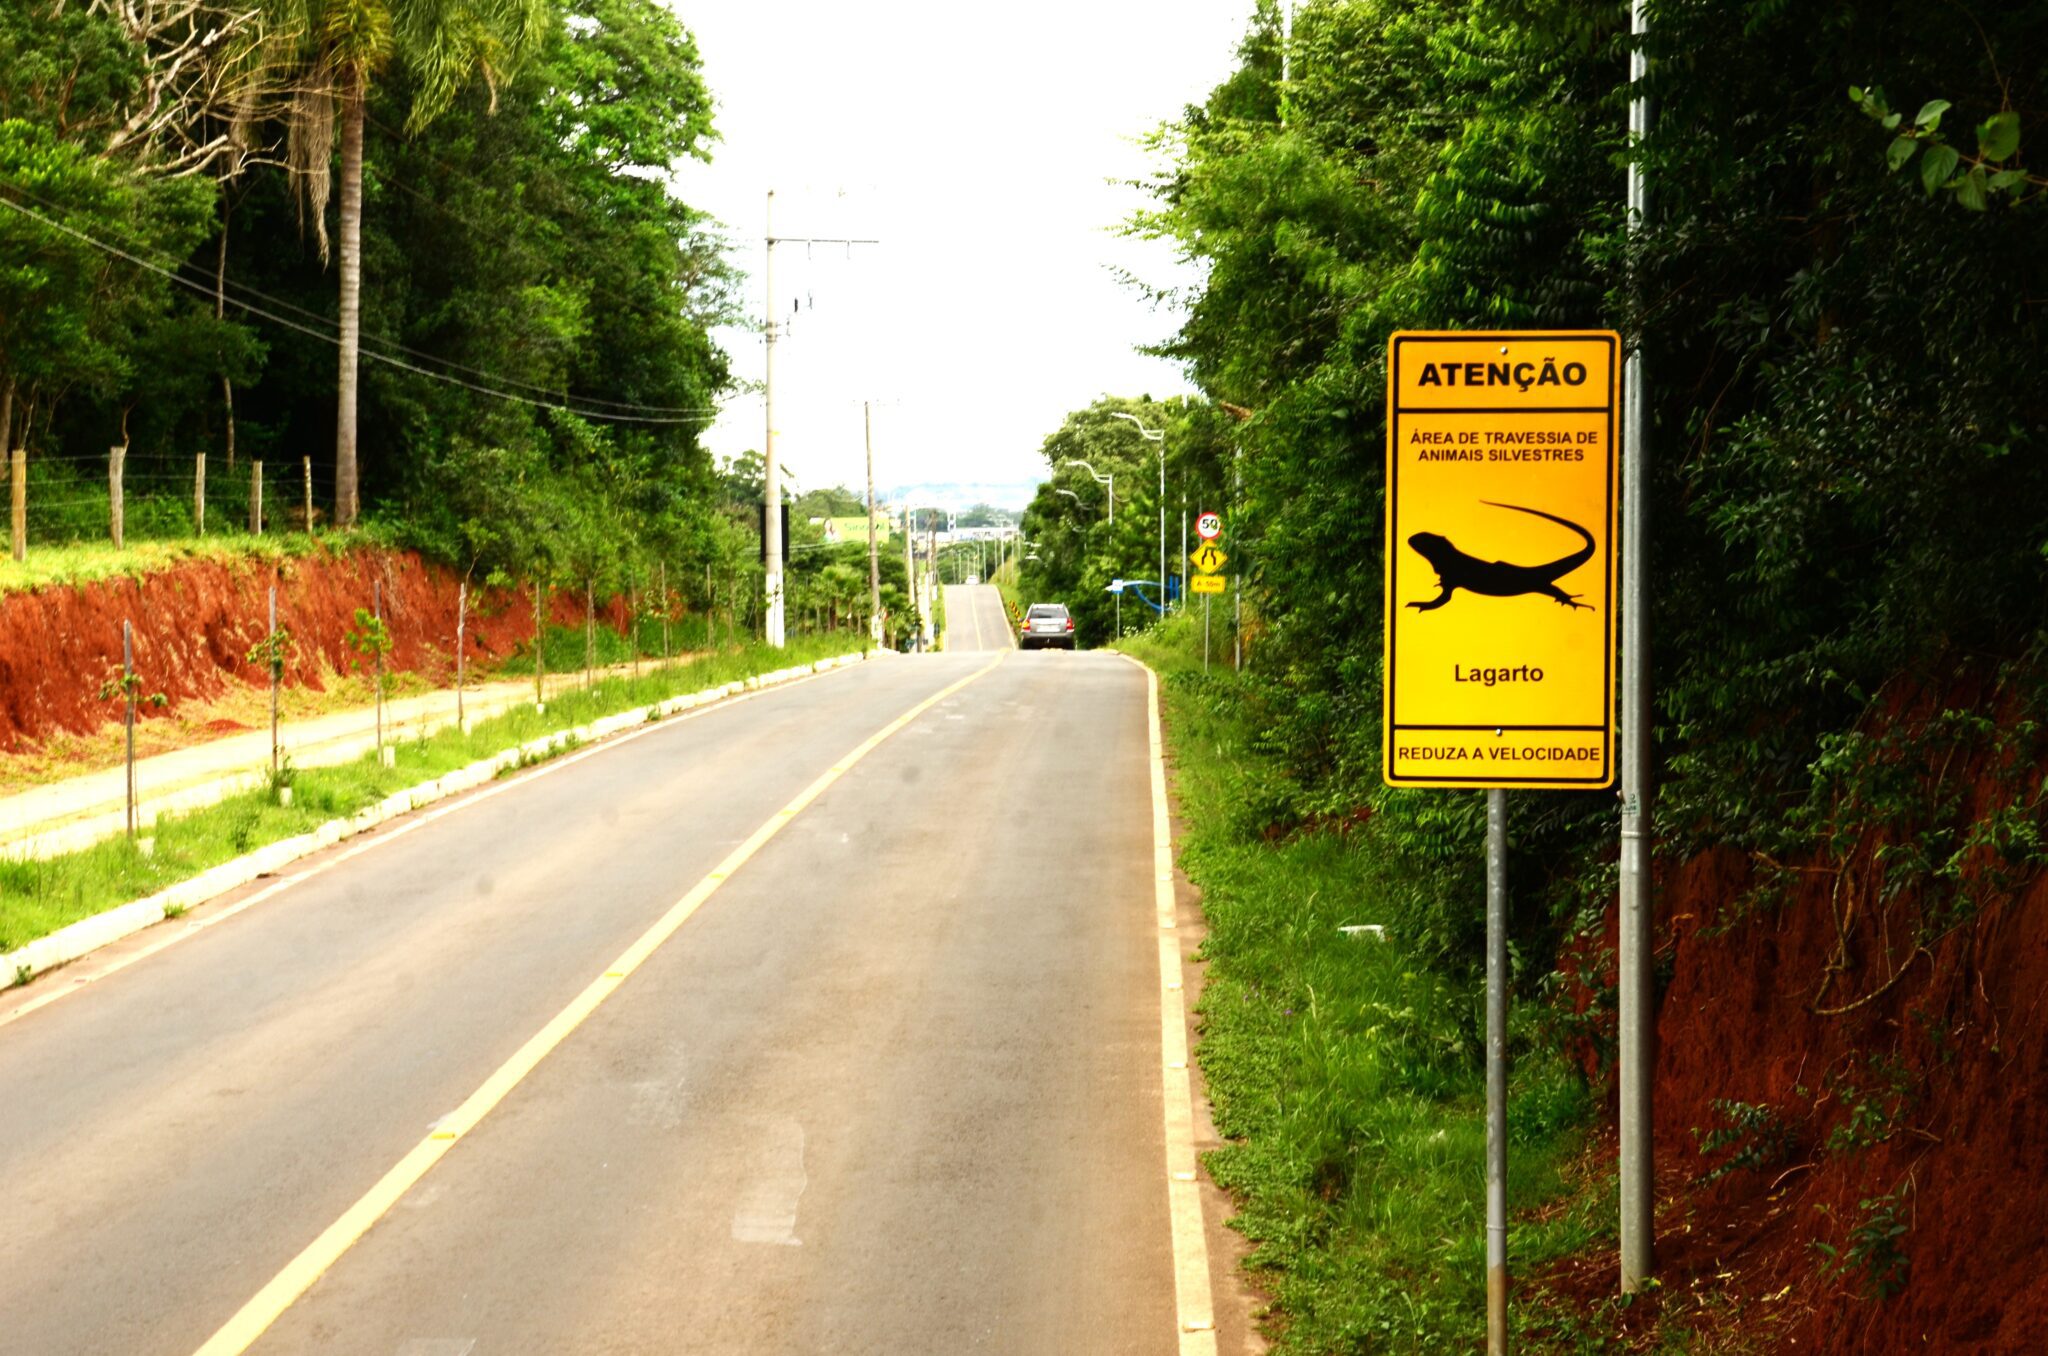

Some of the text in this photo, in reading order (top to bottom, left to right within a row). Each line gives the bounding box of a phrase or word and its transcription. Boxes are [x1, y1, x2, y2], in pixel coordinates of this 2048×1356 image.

[1418, 357, 1587, 392] ATENÇÃO
[1411, 428, 1598, 445] ÁREA DE TRAVESSIA DE
[1418, 449, 1584, 462] ANIMAIS SILVESTRES
[1455, 664, 1544, 686] Lagarto
[1399, 747, 1600, 761] REDUZA A VELOCIDADE
